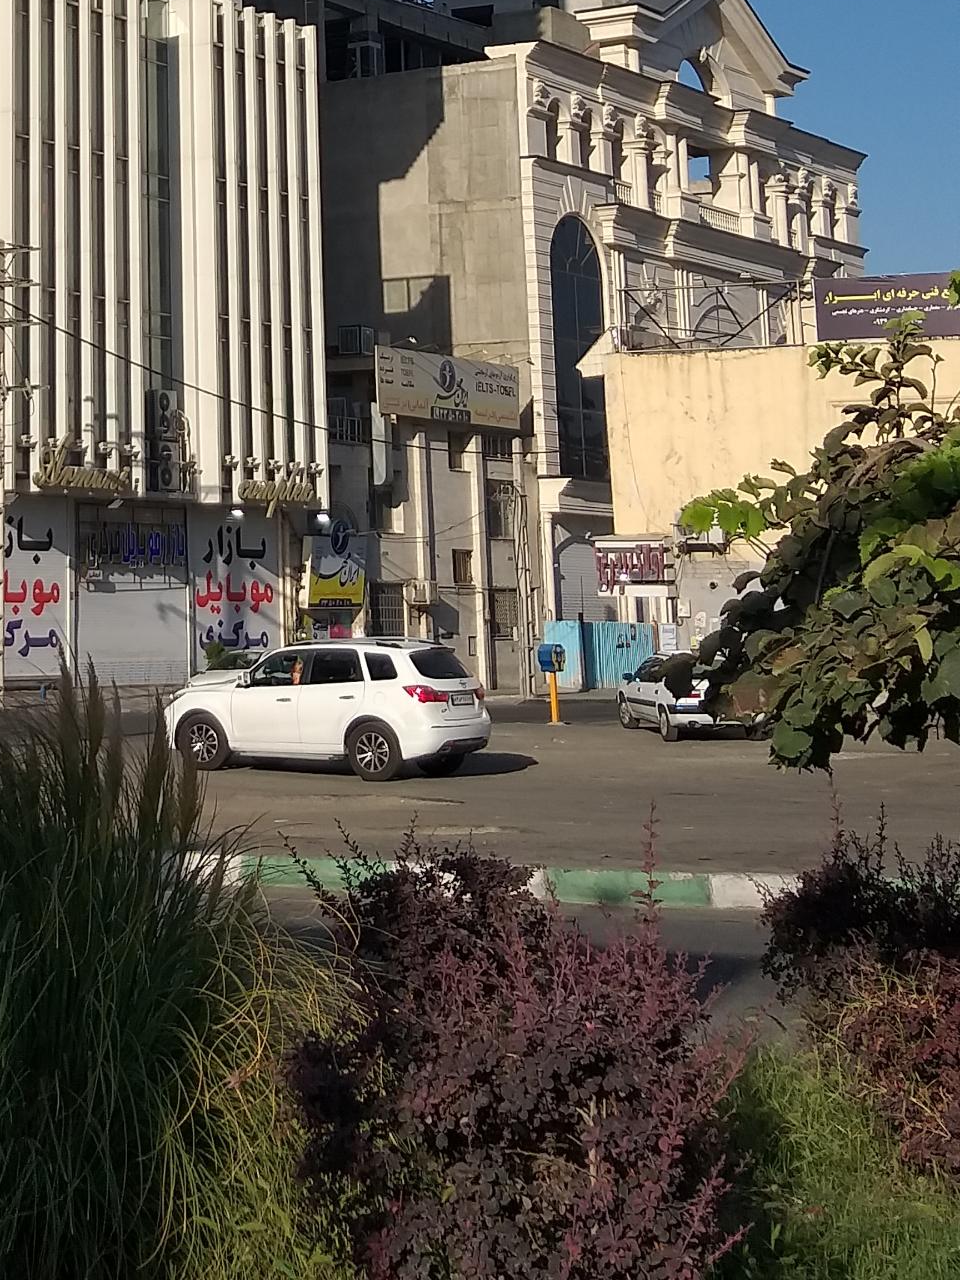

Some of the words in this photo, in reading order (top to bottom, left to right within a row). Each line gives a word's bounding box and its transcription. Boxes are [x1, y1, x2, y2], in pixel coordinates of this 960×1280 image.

[882, 288, 895, 301] ای
[896, 287, 920, 300] حرفه
[921, 284, 940, 300] فنی
[202, 525, 267, 570] بازار
[196, 570, 274, 614] موبایل
[199, 619, 269, 650] مرکزی
